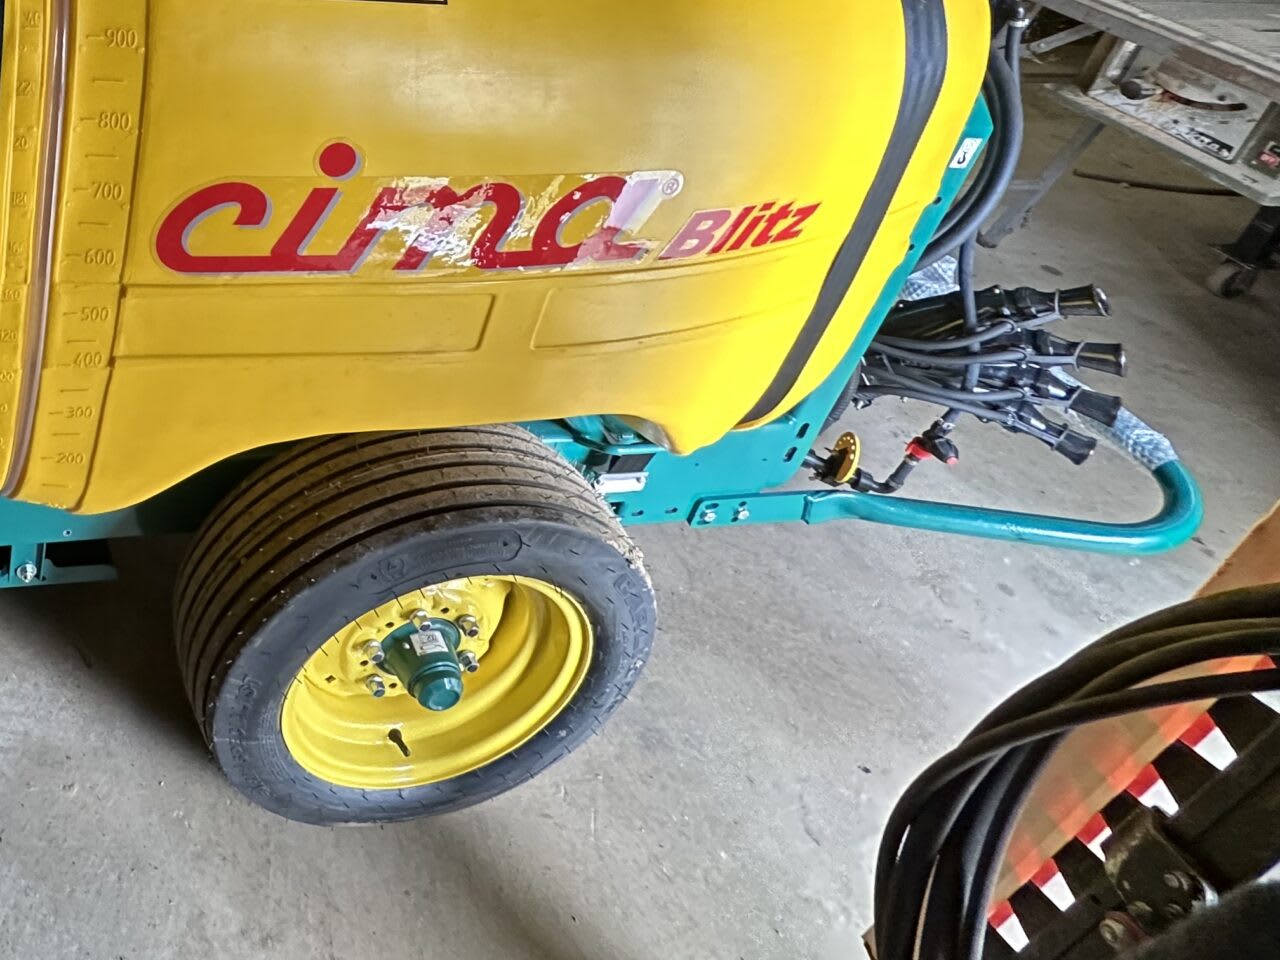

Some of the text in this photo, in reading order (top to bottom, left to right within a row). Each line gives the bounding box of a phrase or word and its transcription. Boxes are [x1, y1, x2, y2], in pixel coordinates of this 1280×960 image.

[106, 28, 139, 48] 900
[97, 111, 132, 130] 800
[92, 181, 124, 200] 700
[657, 199, 823, 261] Blitz
[85, 248, 115, 265] 600
[80, 305, 111, 321] 500
[74, 351, 103, 368] 400
[65, 406, 94, 419] 300
[56, 452, 85, 465] 200
